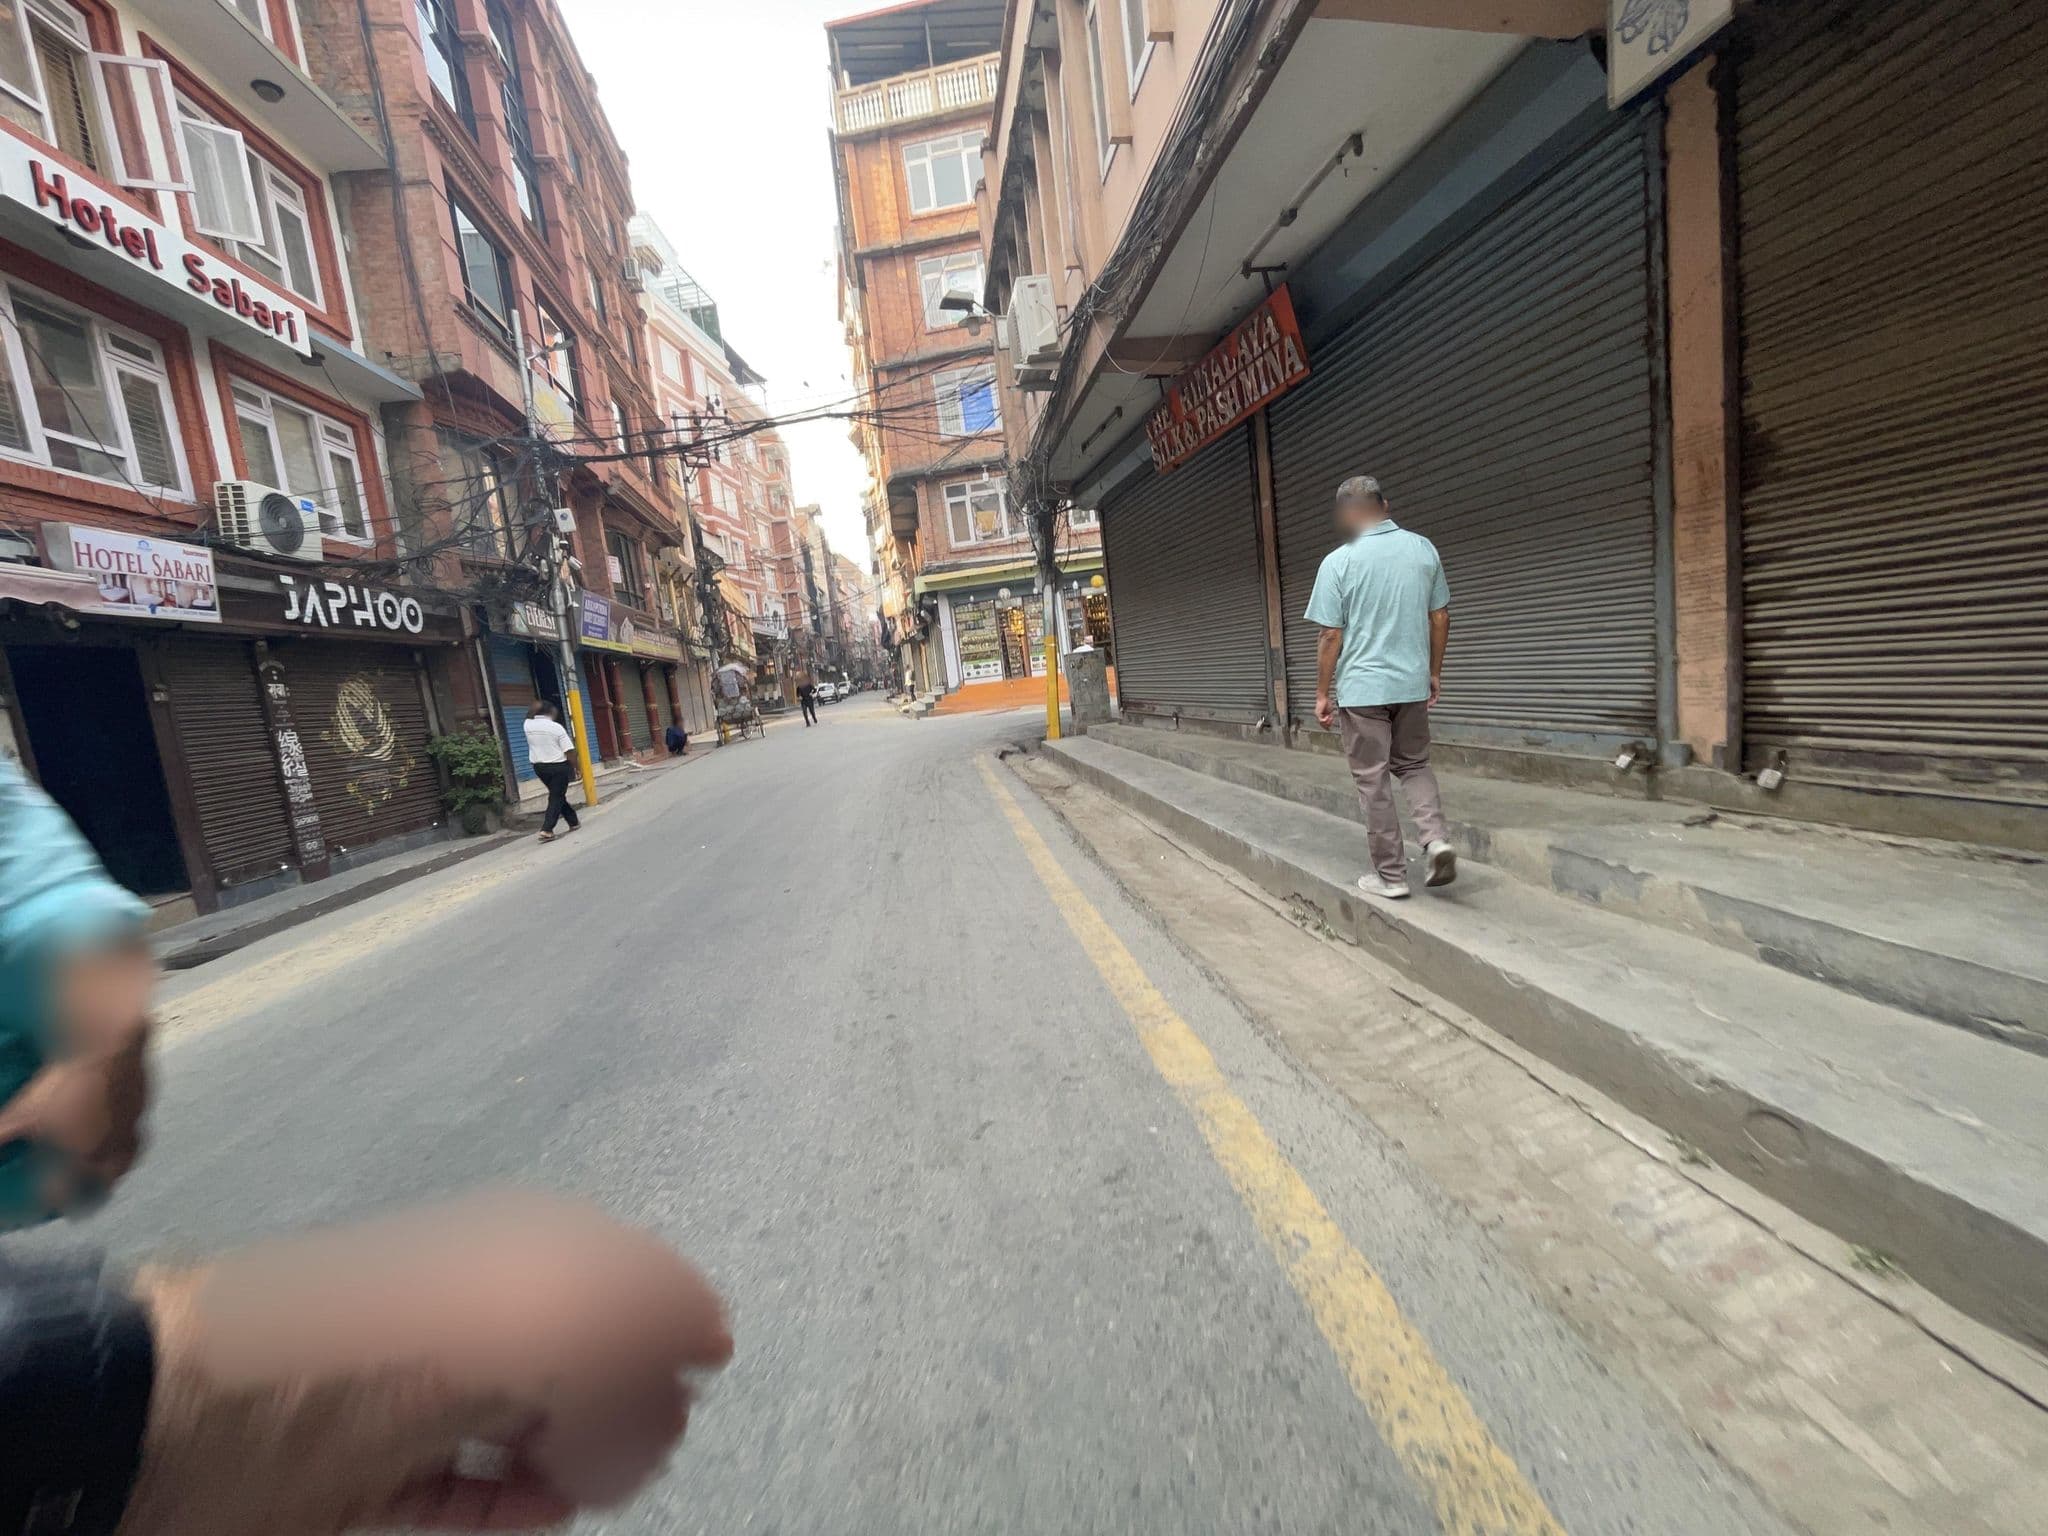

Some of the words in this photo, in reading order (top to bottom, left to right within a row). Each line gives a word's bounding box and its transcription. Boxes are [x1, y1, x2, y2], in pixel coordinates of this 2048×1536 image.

[29, 160, 164, 270] Hotel
[182, 253, 299, 344] Sabari
[1196, 335, 1304, 440] PASHMINA
[74, 541, 148, 575] HOTEL
[152, 553, 211, 583] SABARI
[279, 574, 424, 634] JAPHOO
